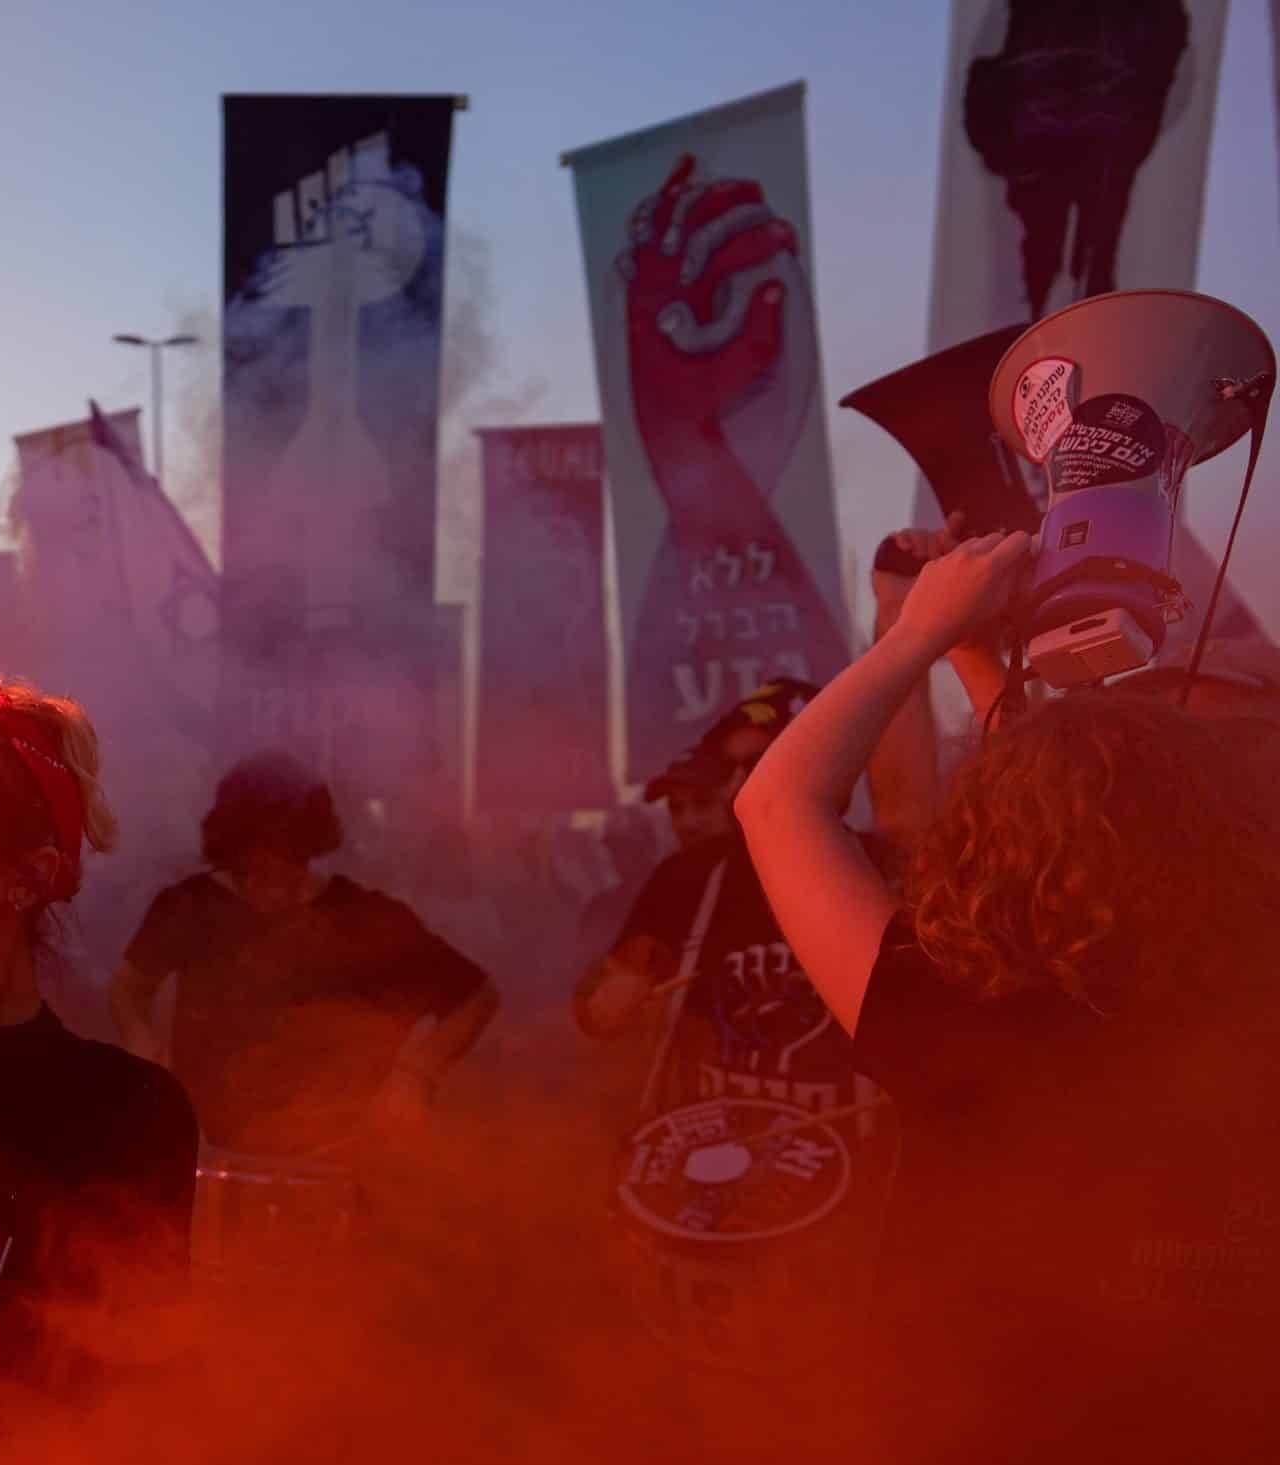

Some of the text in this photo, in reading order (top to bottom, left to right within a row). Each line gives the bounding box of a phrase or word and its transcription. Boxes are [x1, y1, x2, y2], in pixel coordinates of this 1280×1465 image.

[1059, 436, 1111, 454] כיבוש
[1111, 446, 1146, 466] עם
[690, 543, 774, 595] ללא
[675, 602, 800, 645] הבדל
